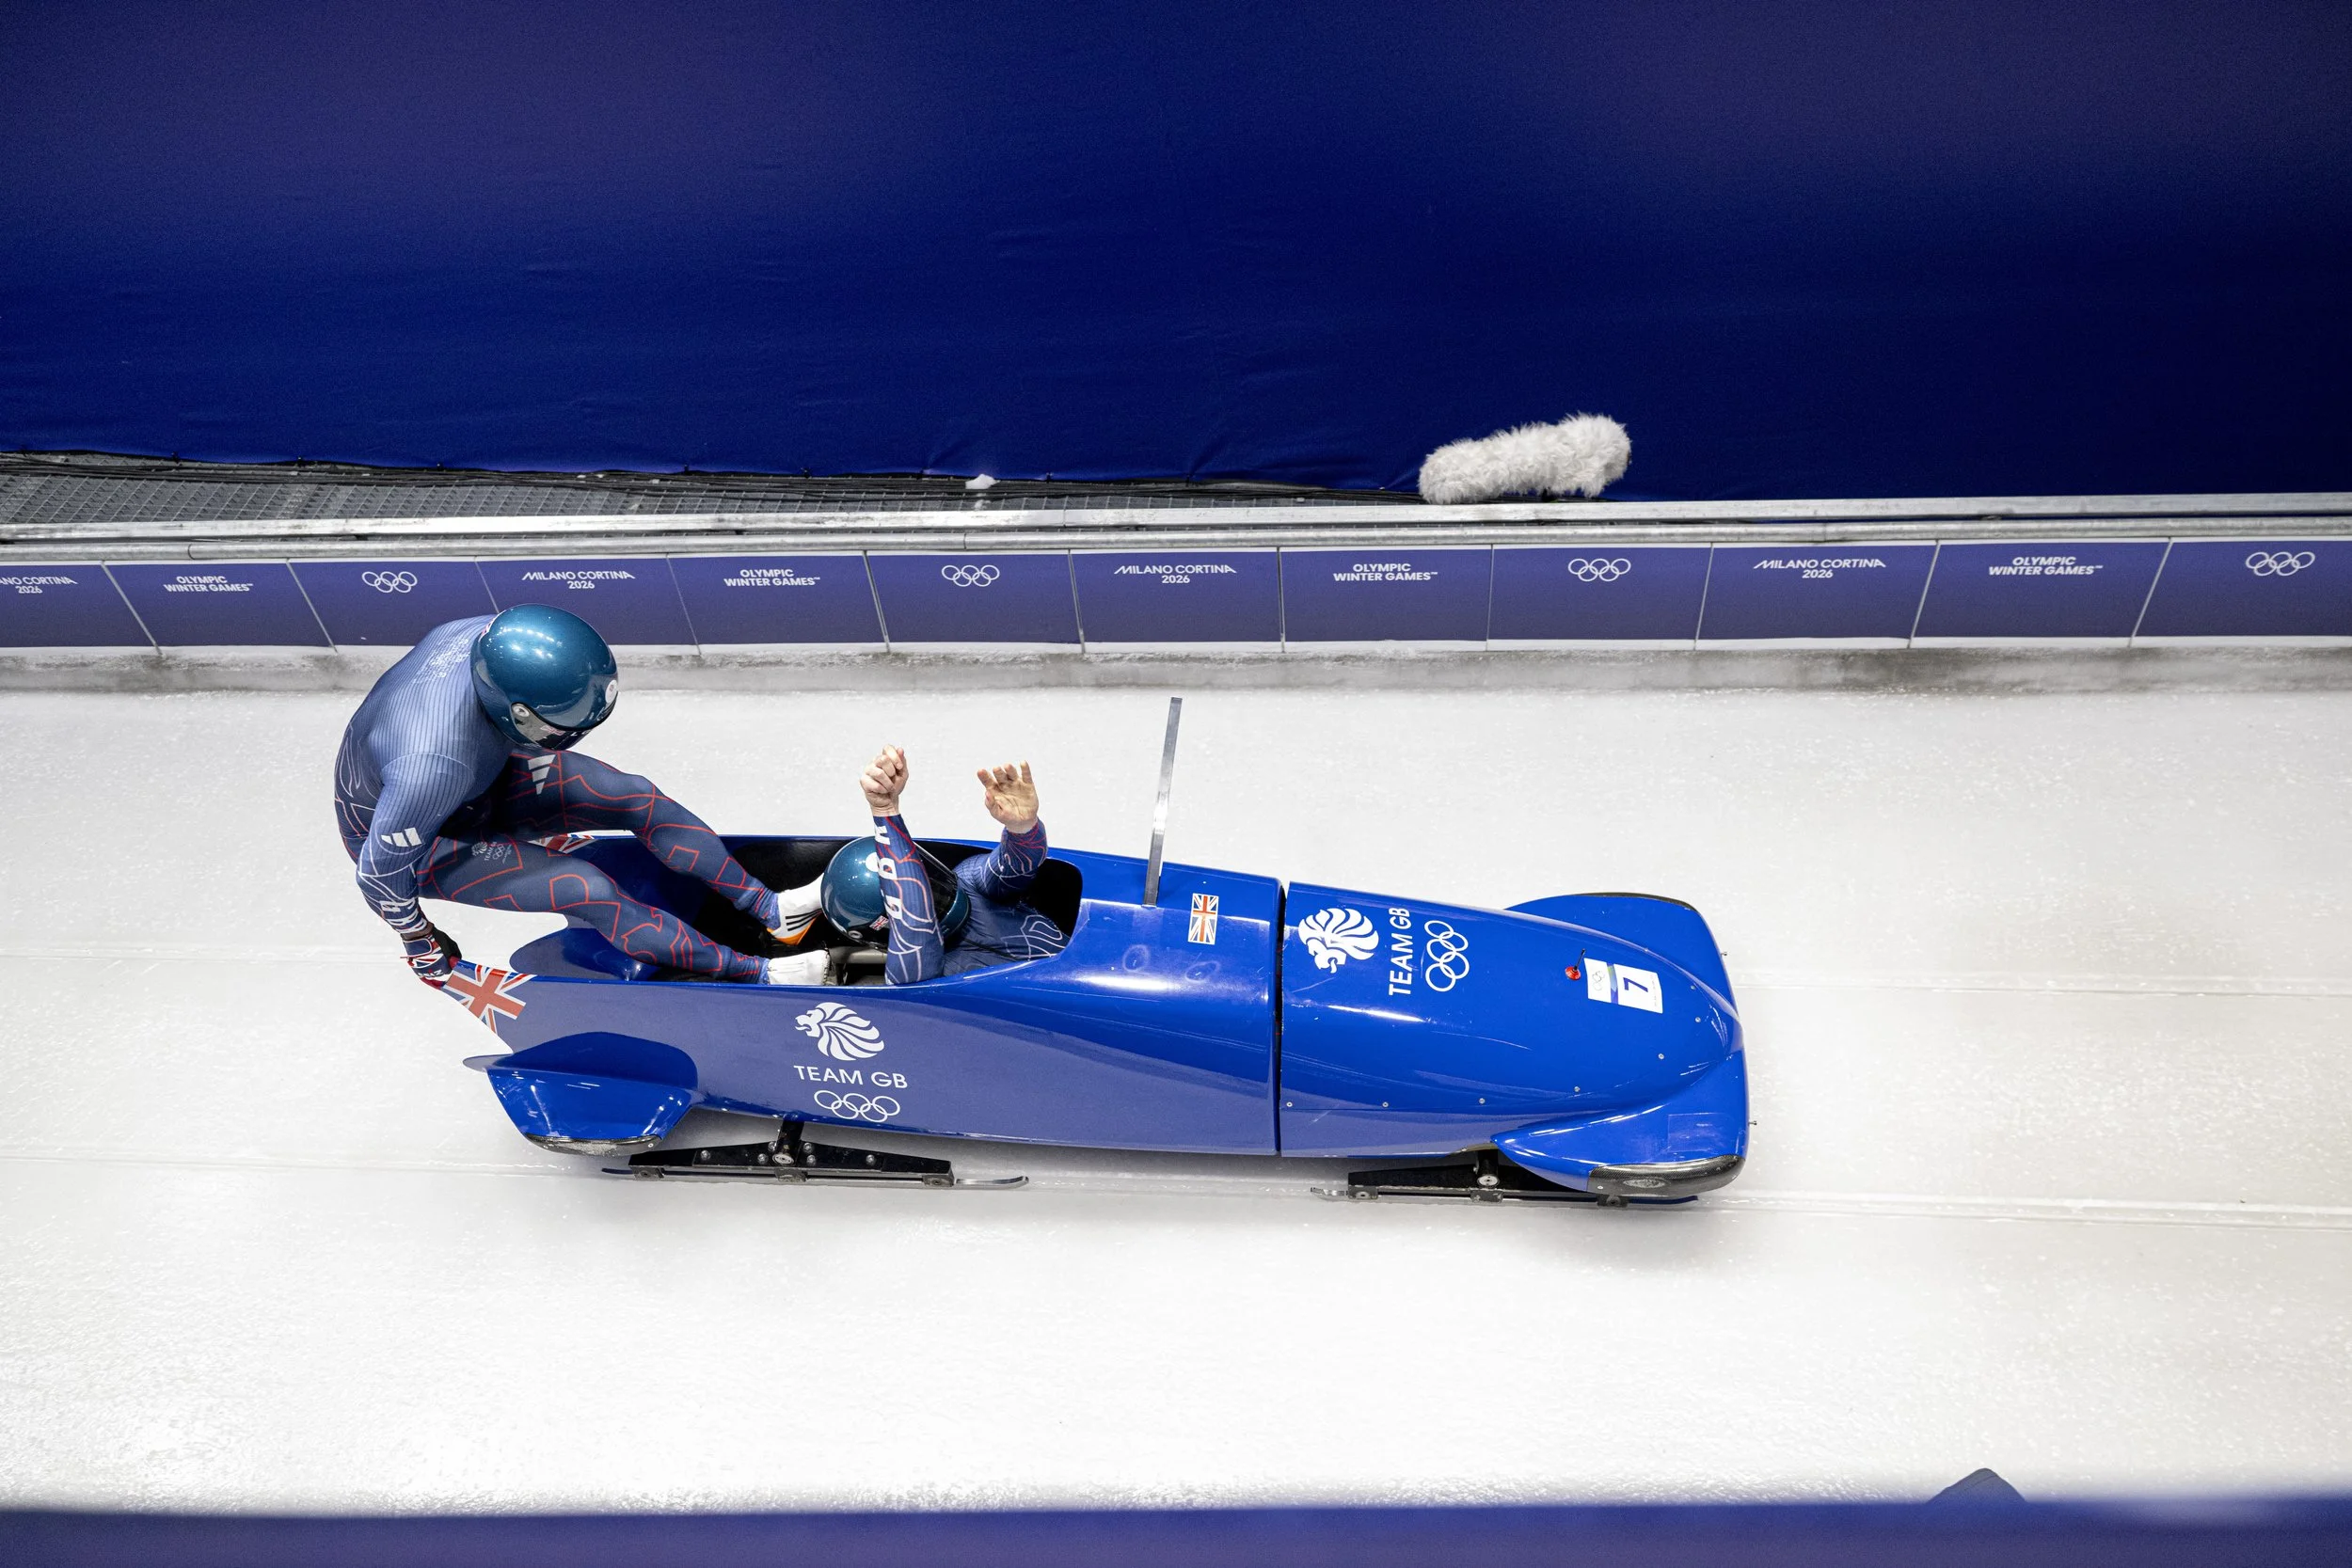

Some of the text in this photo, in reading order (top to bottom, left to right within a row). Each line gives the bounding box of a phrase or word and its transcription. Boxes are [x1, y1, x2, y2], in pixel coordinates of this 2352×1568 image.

[1754, 558, 1886, 569] MILANO CORTINA
[2011, 556, 2076, 566] OLYMPIC
[1114, 564, 1237, 575] MILANO CORTINA
[1352, 562, 1412, 573] OLYMPIC
[1988, 566, 2042, 576] WINTER
[521, 570, 636, 581] MILANO CORTINA
[739, 569, 795, 578] OLYMPIC
[1333, 573, 1383, 582] WINTER
[1802, 569, 1834, 578] 2026
[22, 576, 78, 585] CORTINA
[176, 576, 228, 584] OLYMPIC
[723, 578, 771, 587] WINTER
[1161, 575, 1191, 584] 2026
[15, 585, 43, 594] 2026
[163, 584, 209, 593] WINTER
[566, 580, 596, 590] 2026
[1388, 907, 1414, 996] TEAM GB
[1622, 976, 1649, 993] 7
[793, 1065, 908, 1089] TEAM GB
